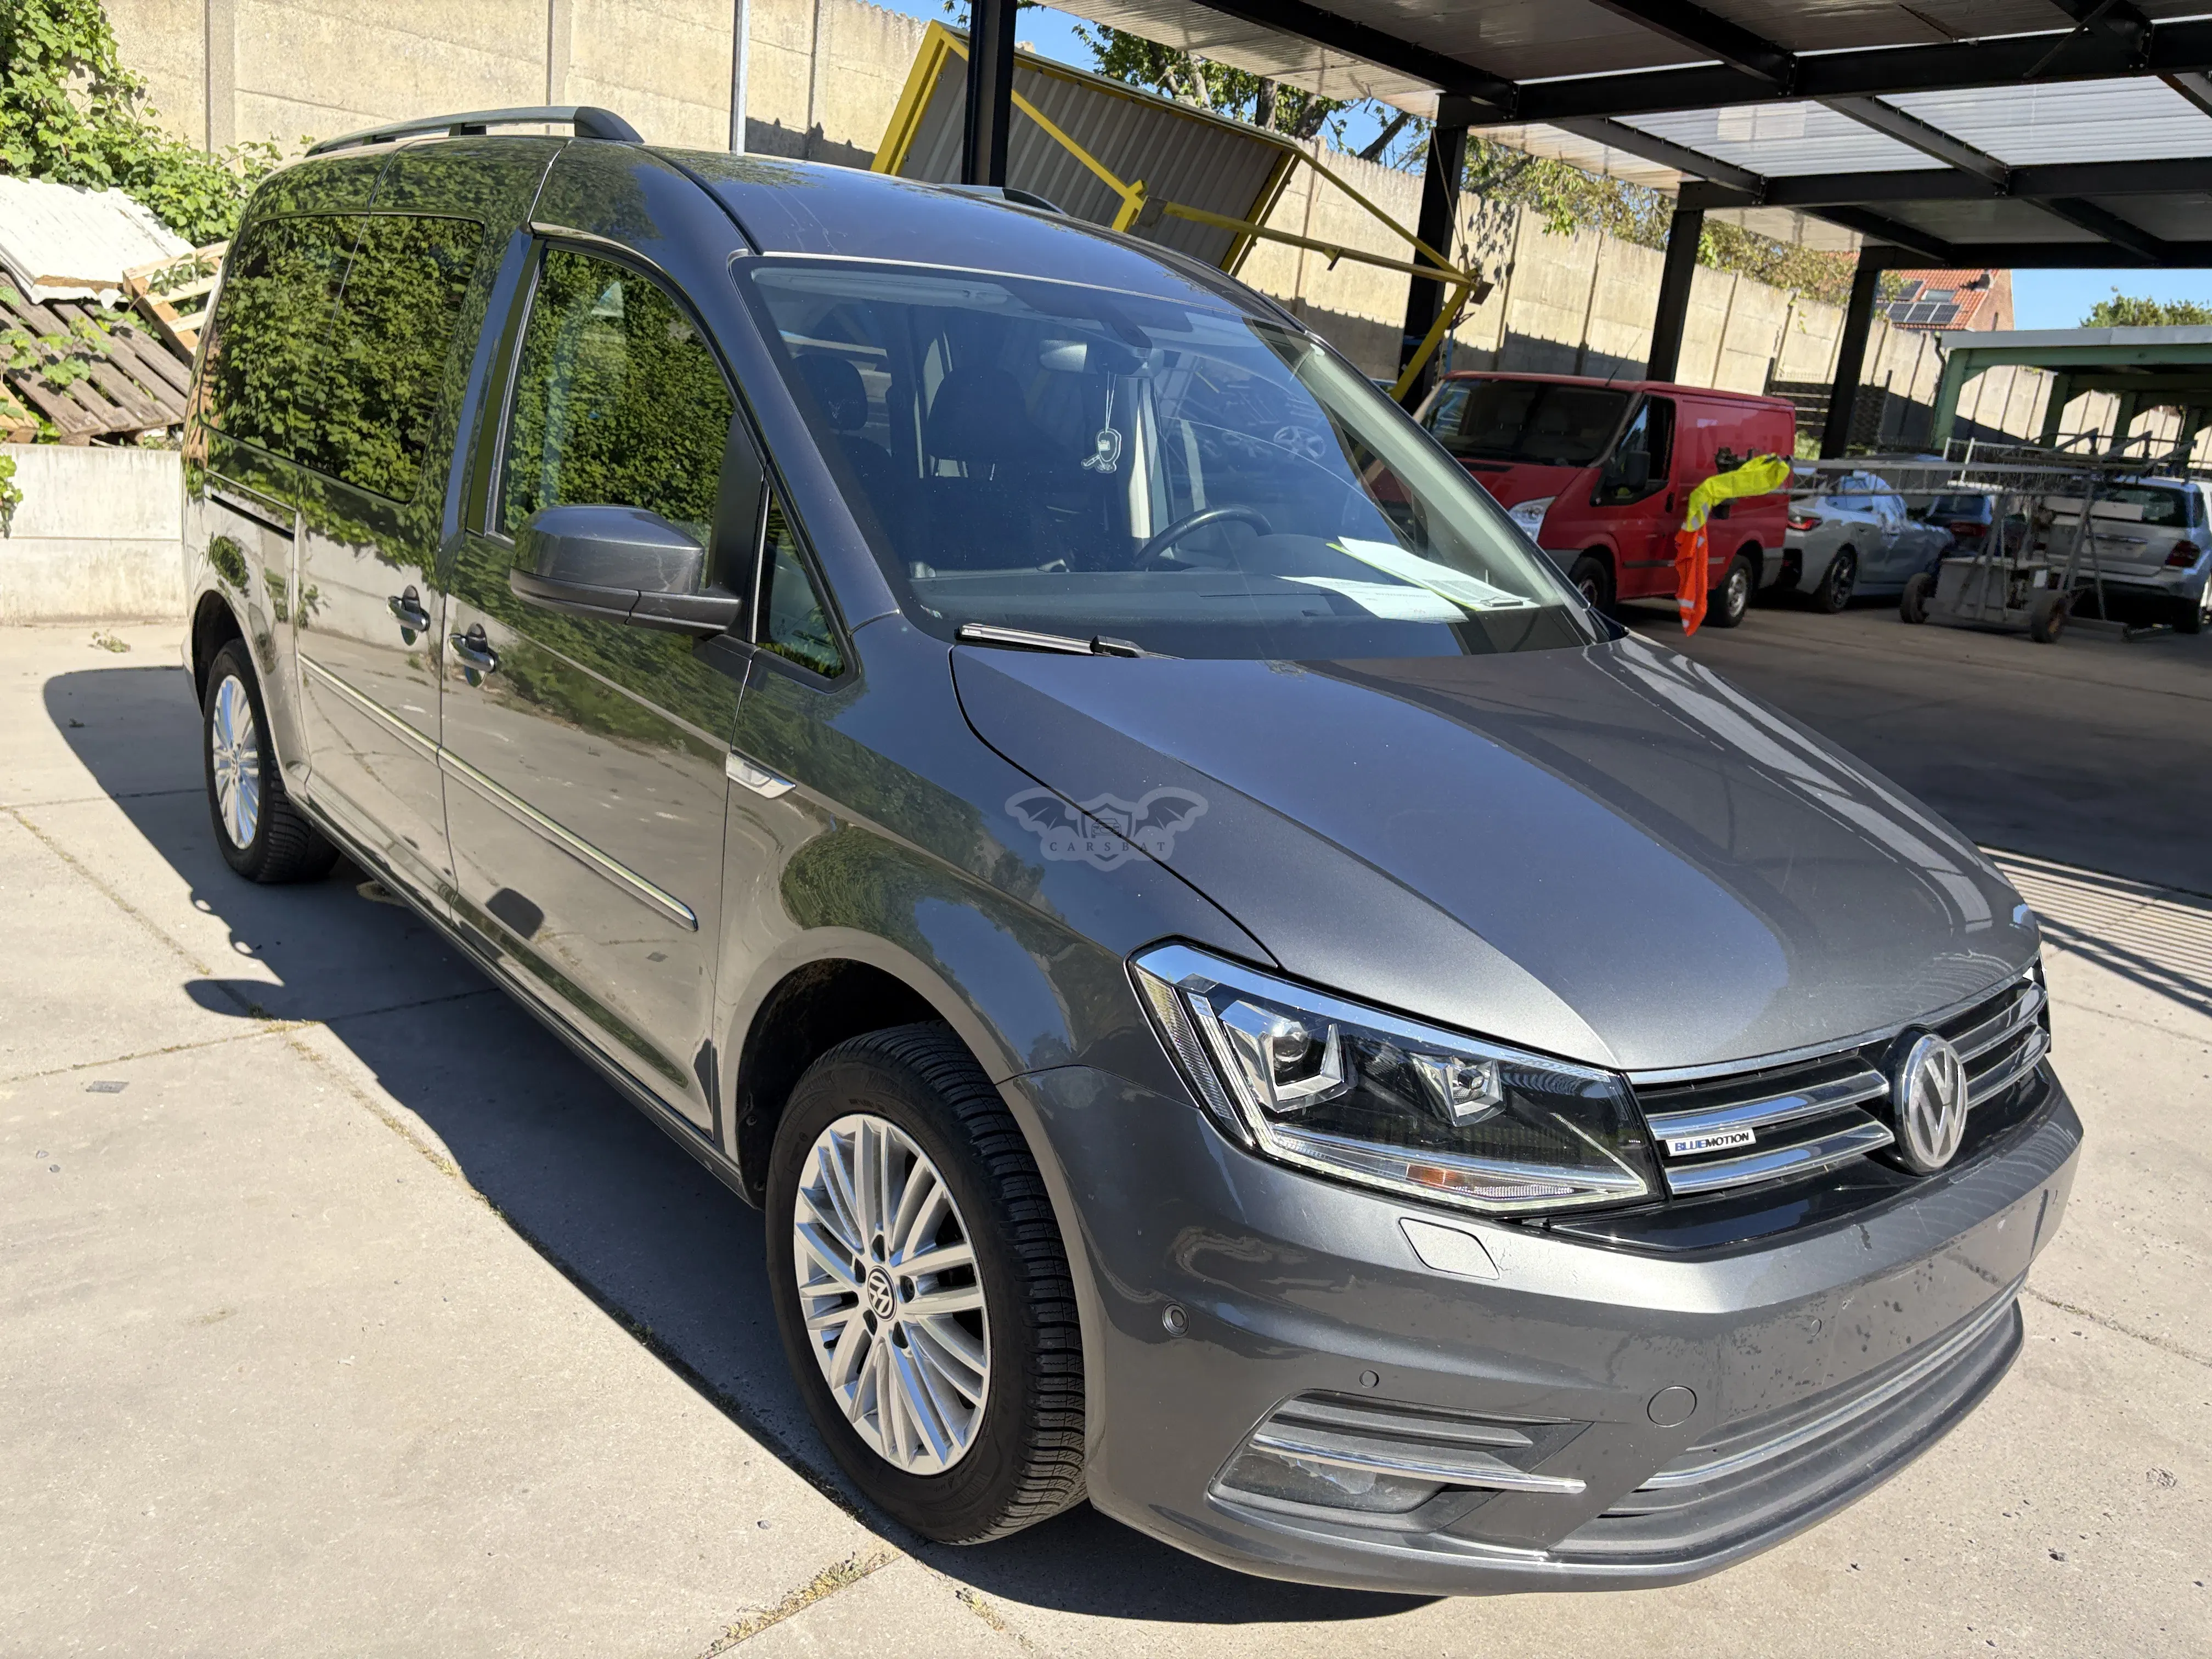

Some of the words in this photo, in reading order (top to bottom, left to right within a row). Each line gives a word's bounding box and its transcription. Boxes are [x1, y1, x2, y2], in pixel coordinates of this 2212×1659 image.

[1906, 1036, 1966, 1165] VW
[1674, 1132, 1750, 1152] BLUEMOTION
[868, 1268, 895, 1319] VW
